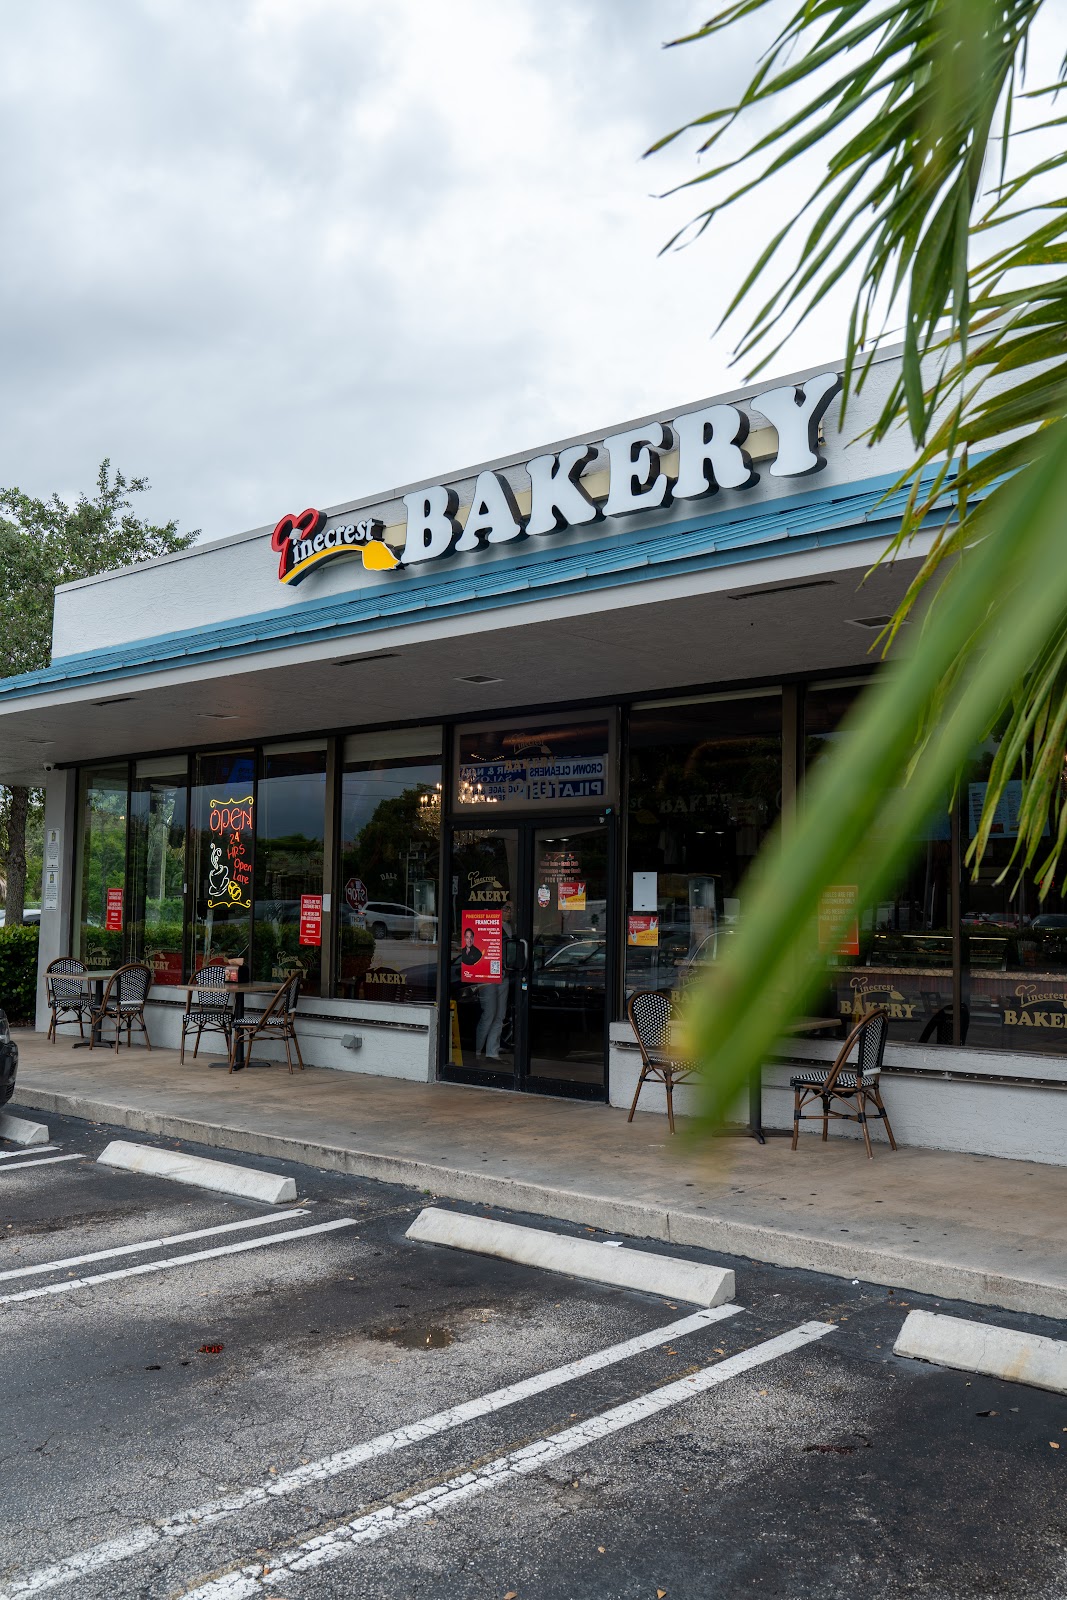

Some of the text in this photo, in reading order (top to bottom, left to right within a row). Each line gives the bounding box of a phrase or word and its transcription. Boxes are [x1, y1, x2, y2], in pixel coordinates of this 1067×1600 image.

[400, 372, 842, 564] BAKERY
[209, 806, 253, 836] OPEN
[233, 858, 252, 873] Open
[84, 957, 112, 967] BAKERY
[365, 972, 407, 985] BAKERY
